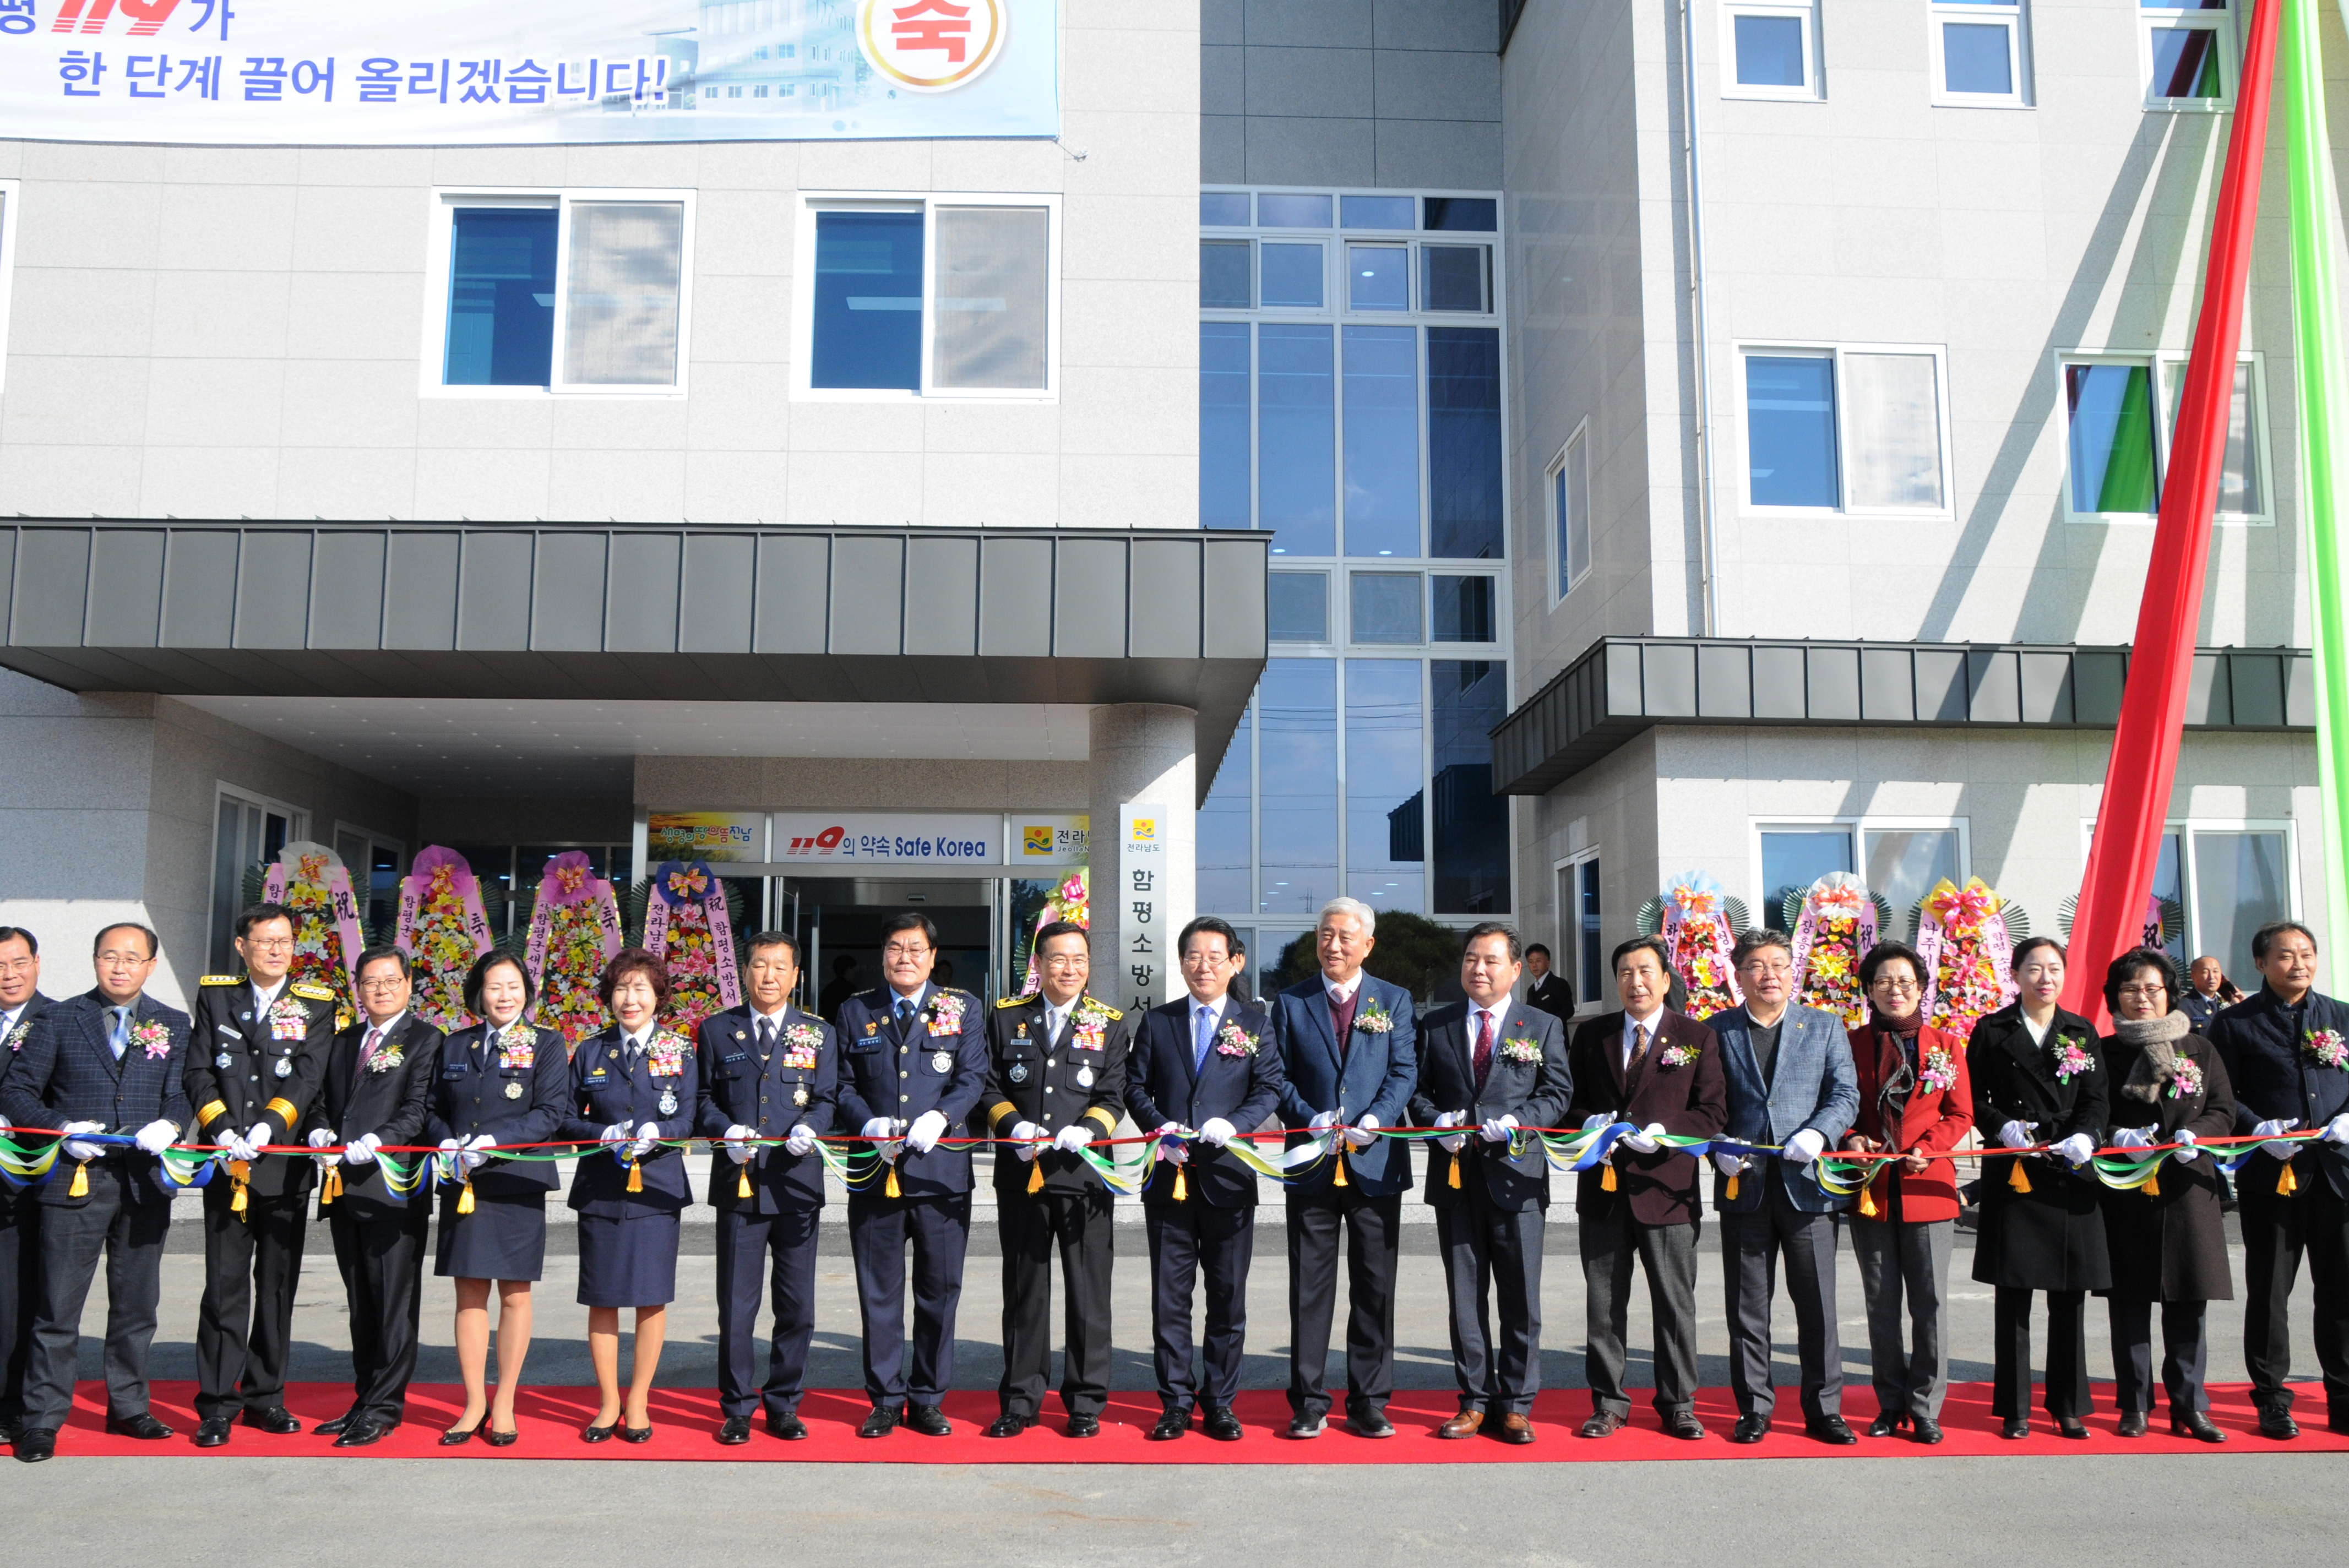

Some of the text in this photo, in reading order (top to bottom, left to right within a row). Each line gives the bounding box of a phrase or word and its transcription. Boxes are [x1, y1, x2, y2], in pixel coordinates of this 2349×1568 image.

[59, 51, 665, 104] 한 단계 끌어 올리겠습니다!
[861, 835, 890, 857] 약속
[895, 836, 931, 857] Safe
[937, 837, 986, 857] Korea
[1057, 830, 1089, 844] 전라
[1127, 843, 1160, 852] 전라남도
[334, 891, 355, 921] 祝
[400, 895, 416, 938] 함평군
[708, 896, 725, 912] 祝
[470, 913, 486, 939] 축
[601, 906, 616, 933] 축
[1129, 869, 1155, 1012] 함평소방서
[1860, 923, 1876, 950] 祝
[2143, 923, 2163, 950] 祝
[714, 921, 736, 1003] 함평소방서
